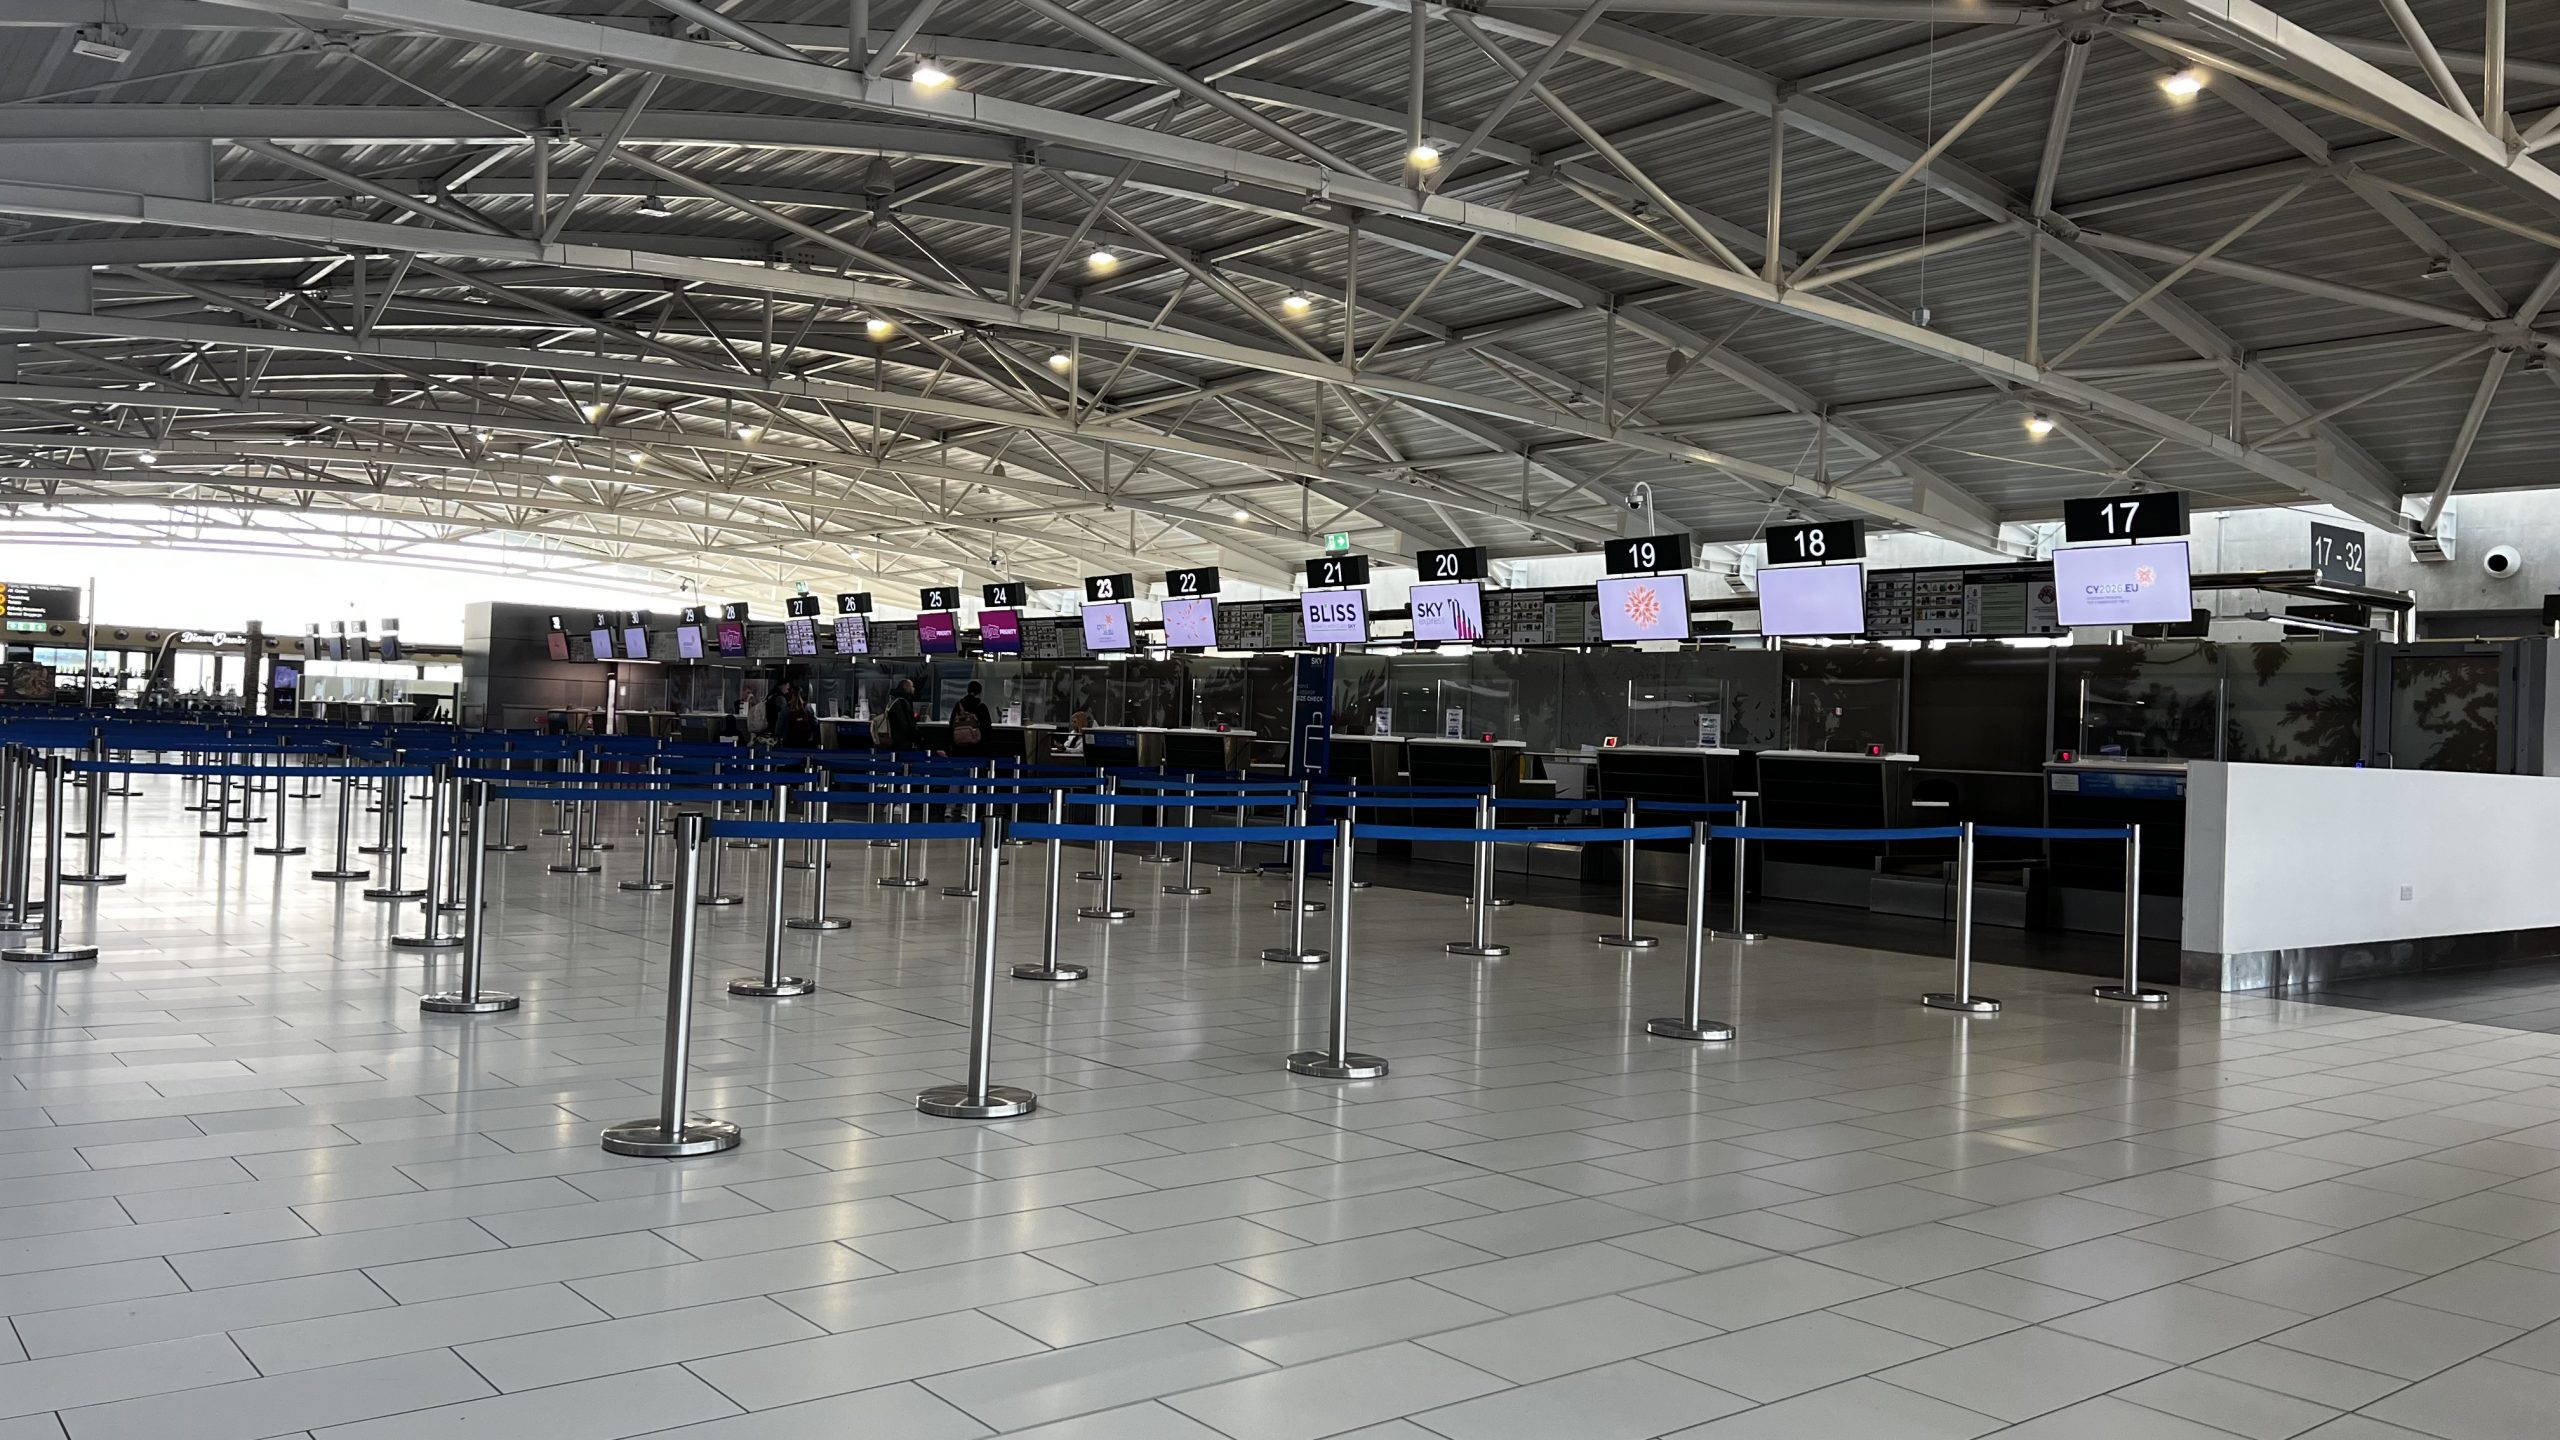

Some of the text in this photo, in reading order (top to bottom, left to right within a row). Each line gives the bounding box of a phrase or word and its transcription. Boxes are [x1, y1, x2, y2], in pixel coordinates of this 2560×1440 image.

[2100, 502, 2140, 534] 17
[1794, 529, 1826, 558] 18
[1628, 542, 1656, 569] 19
[2315, 536, 2333, 566] 17
[2345, 541, 2363, 573] 32
[1324, 562, 1343, 584] 21
[1436, 553, 1458, 577] 20
[1096, 578, 1113, 599] 23
[1179, 573, 1197, 593] 22
[2085, 583, 2139, 595] CY2026.EU
[844, 596, 857, 612] 26
[929, 591, 943, 608] 25
[993, 587, 1007, 604] 24
[685, 608, 695, 622] 29
[725, 605, 736, 620] 28
[793, 600, 804, 615] 27
[1309, 604, 1356, 623] BLISS
[1417, 602, 1443, 617] SKY
[596, 613, 606, 626] 31
[630, 611, 640, 624] 30
[1311, 657, 1323, 665] SKY
